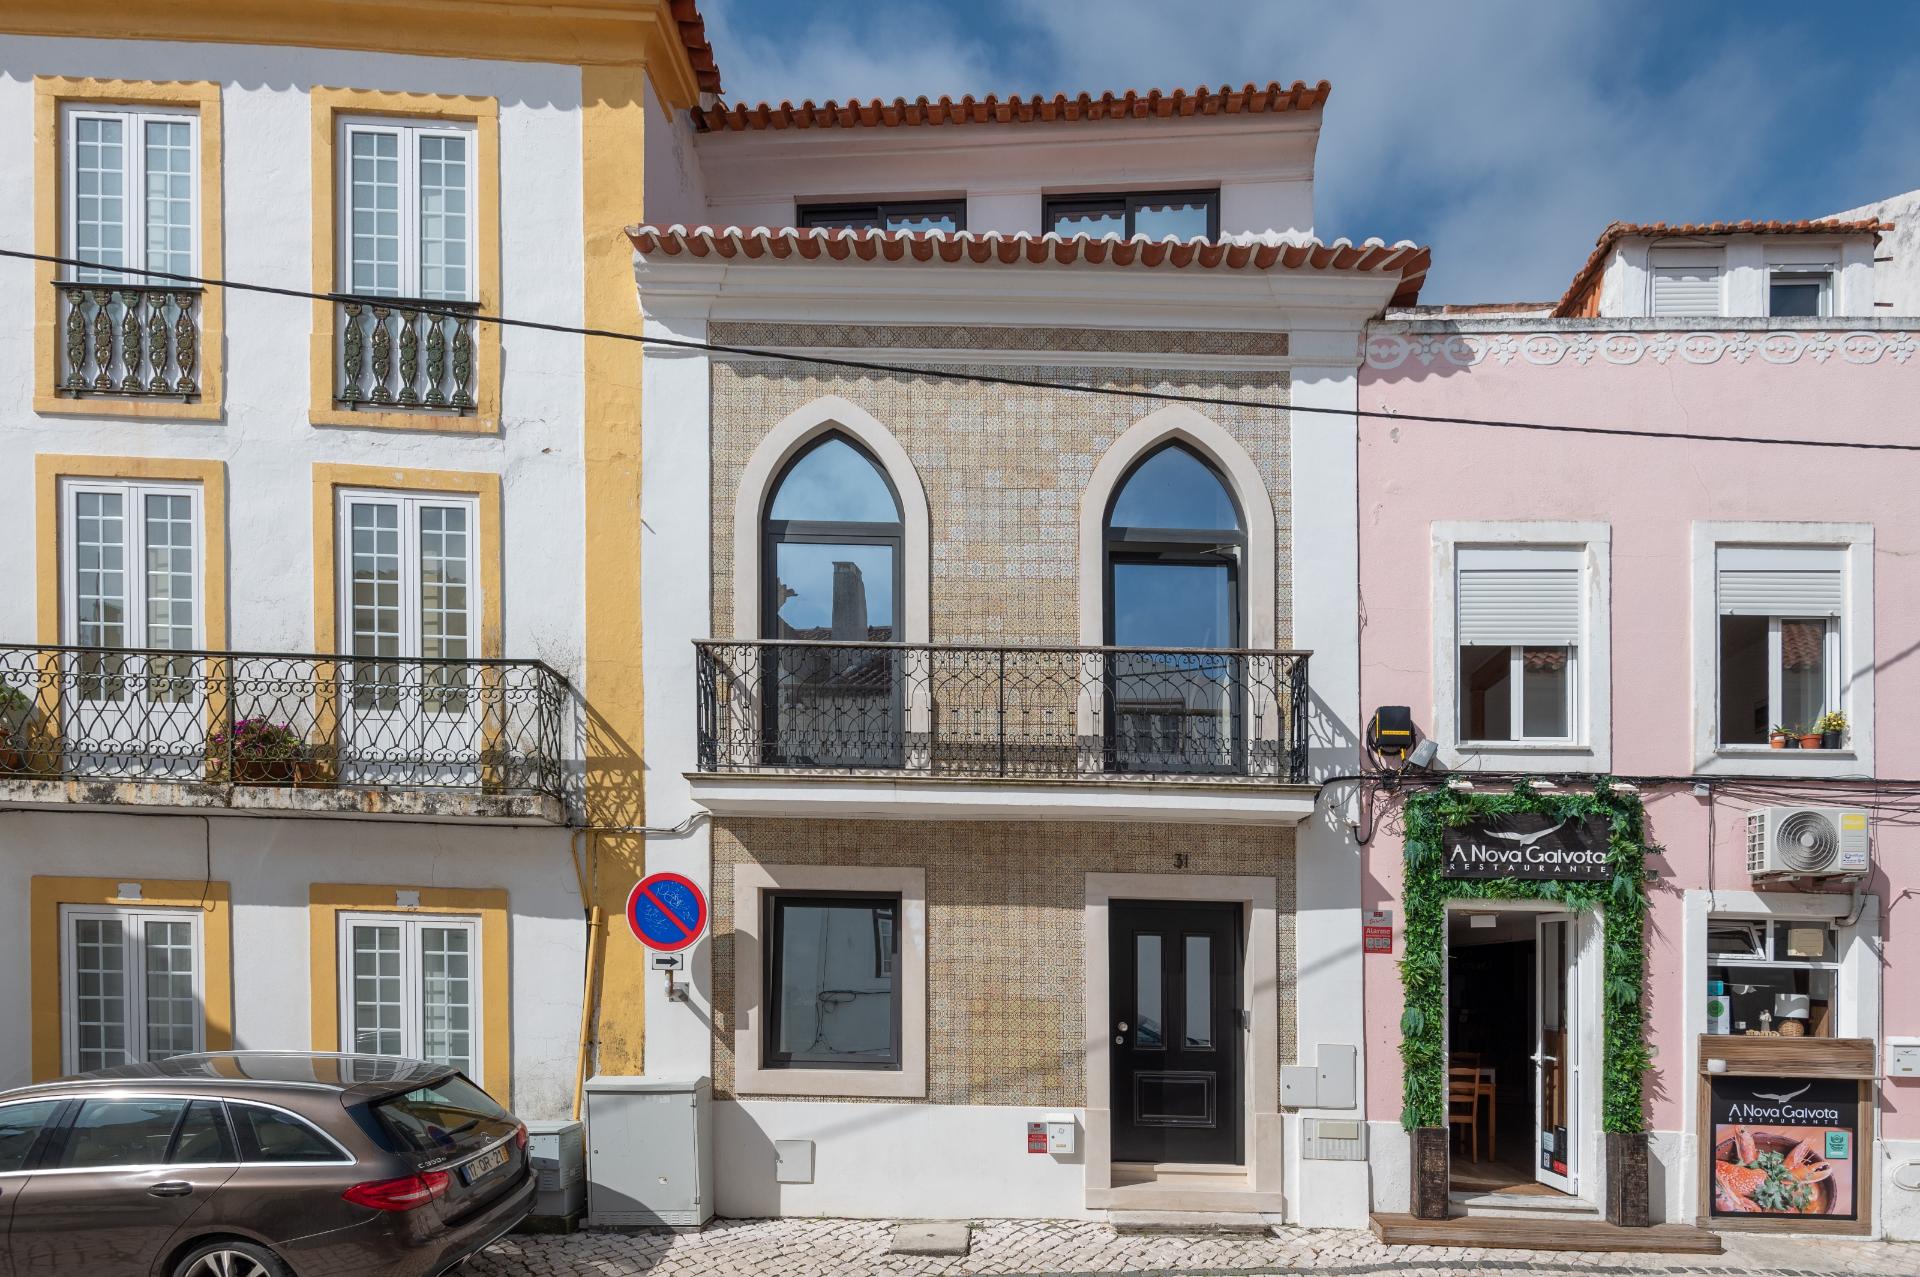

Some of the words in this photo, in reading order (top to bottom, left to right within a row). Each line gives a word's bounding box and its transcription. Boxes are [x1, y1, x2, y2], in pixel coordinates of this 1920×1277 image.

[1173, 853, 1188, 869] 31
[1450, 844, 1467, 862] A
[1471, 844, 1522, 863] Nova
[1450, 863, 1606, 873] RESTAURANTE
[1728, 1103, 1741, 1117] A
[1743, 1103, 1779, 1118] Nova
[1728, 1117, 1839, 1125] RESTAURANTE
